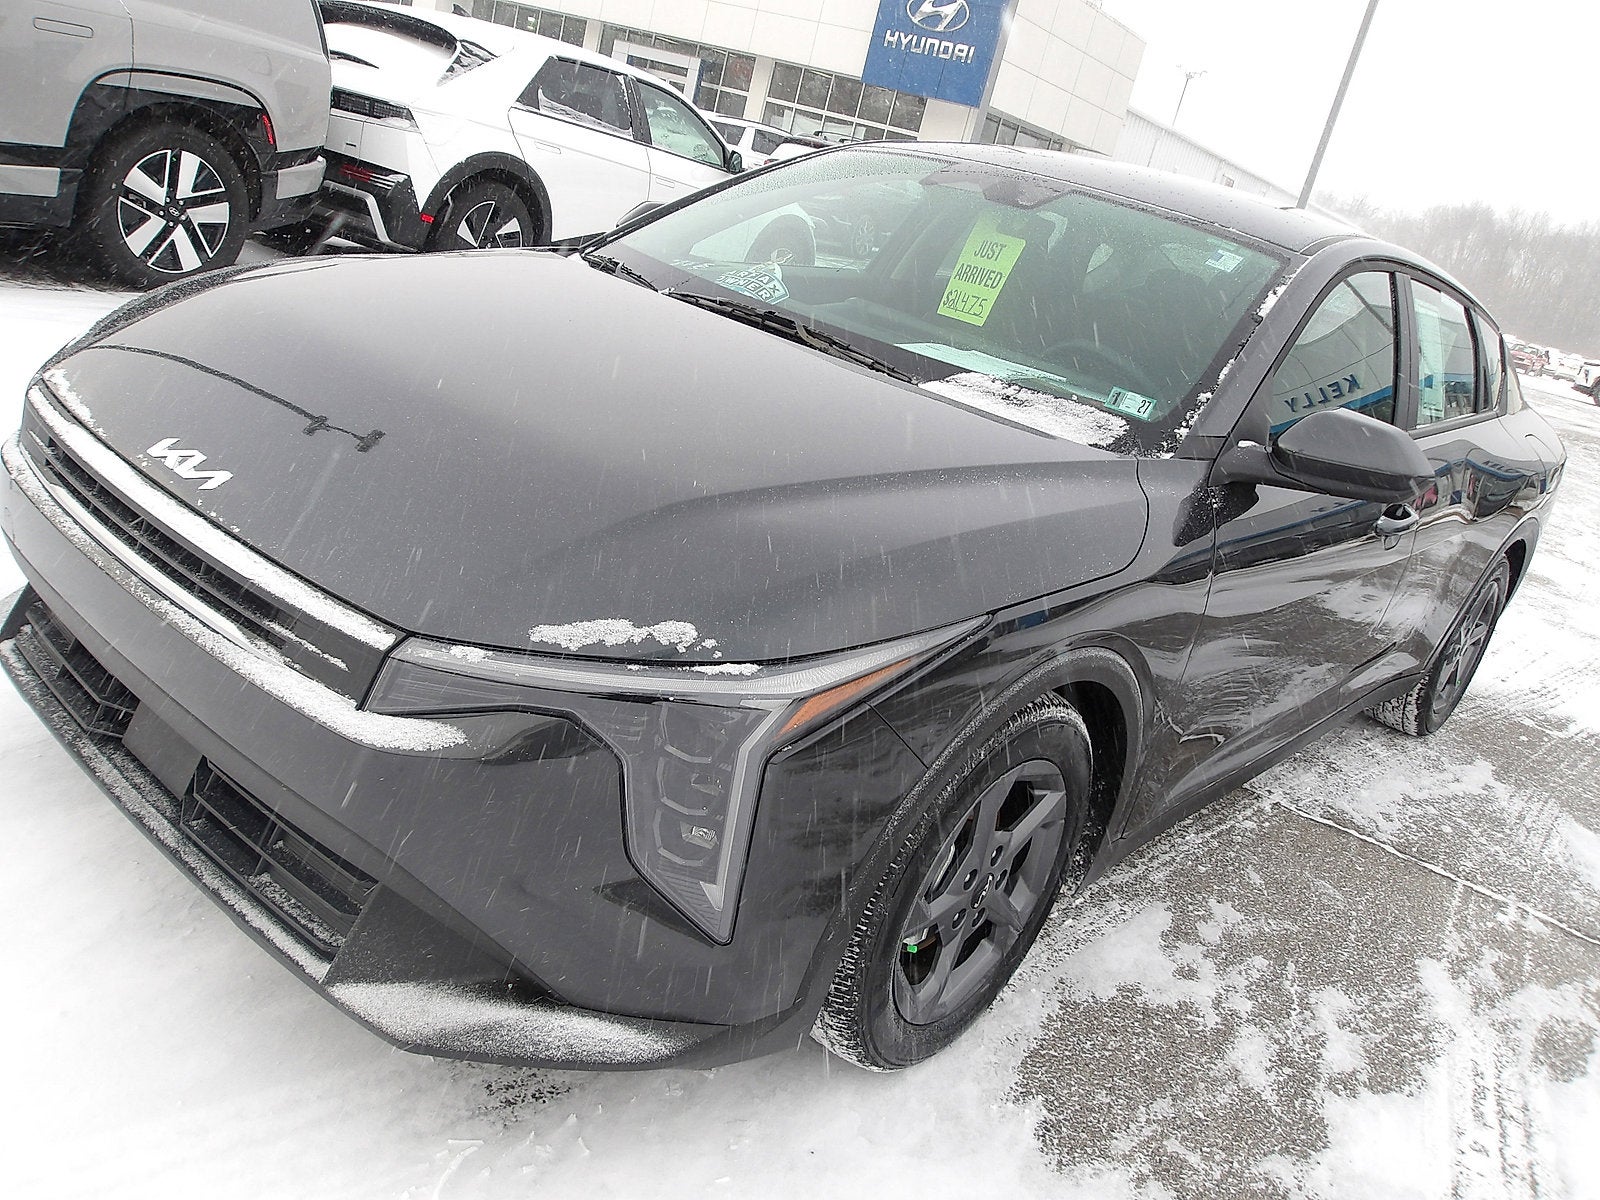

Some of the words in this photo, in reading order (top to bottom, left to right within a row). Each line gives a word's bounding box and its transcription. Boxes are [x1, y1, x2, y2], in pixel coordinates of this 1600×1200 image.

[883, 29, 976, 64] HYUNDAI
[974, 240, 1007, 261] JUST
[953, 263, 1003, 289] ARRIVED
[1137, 399, 1152, 415] 27
